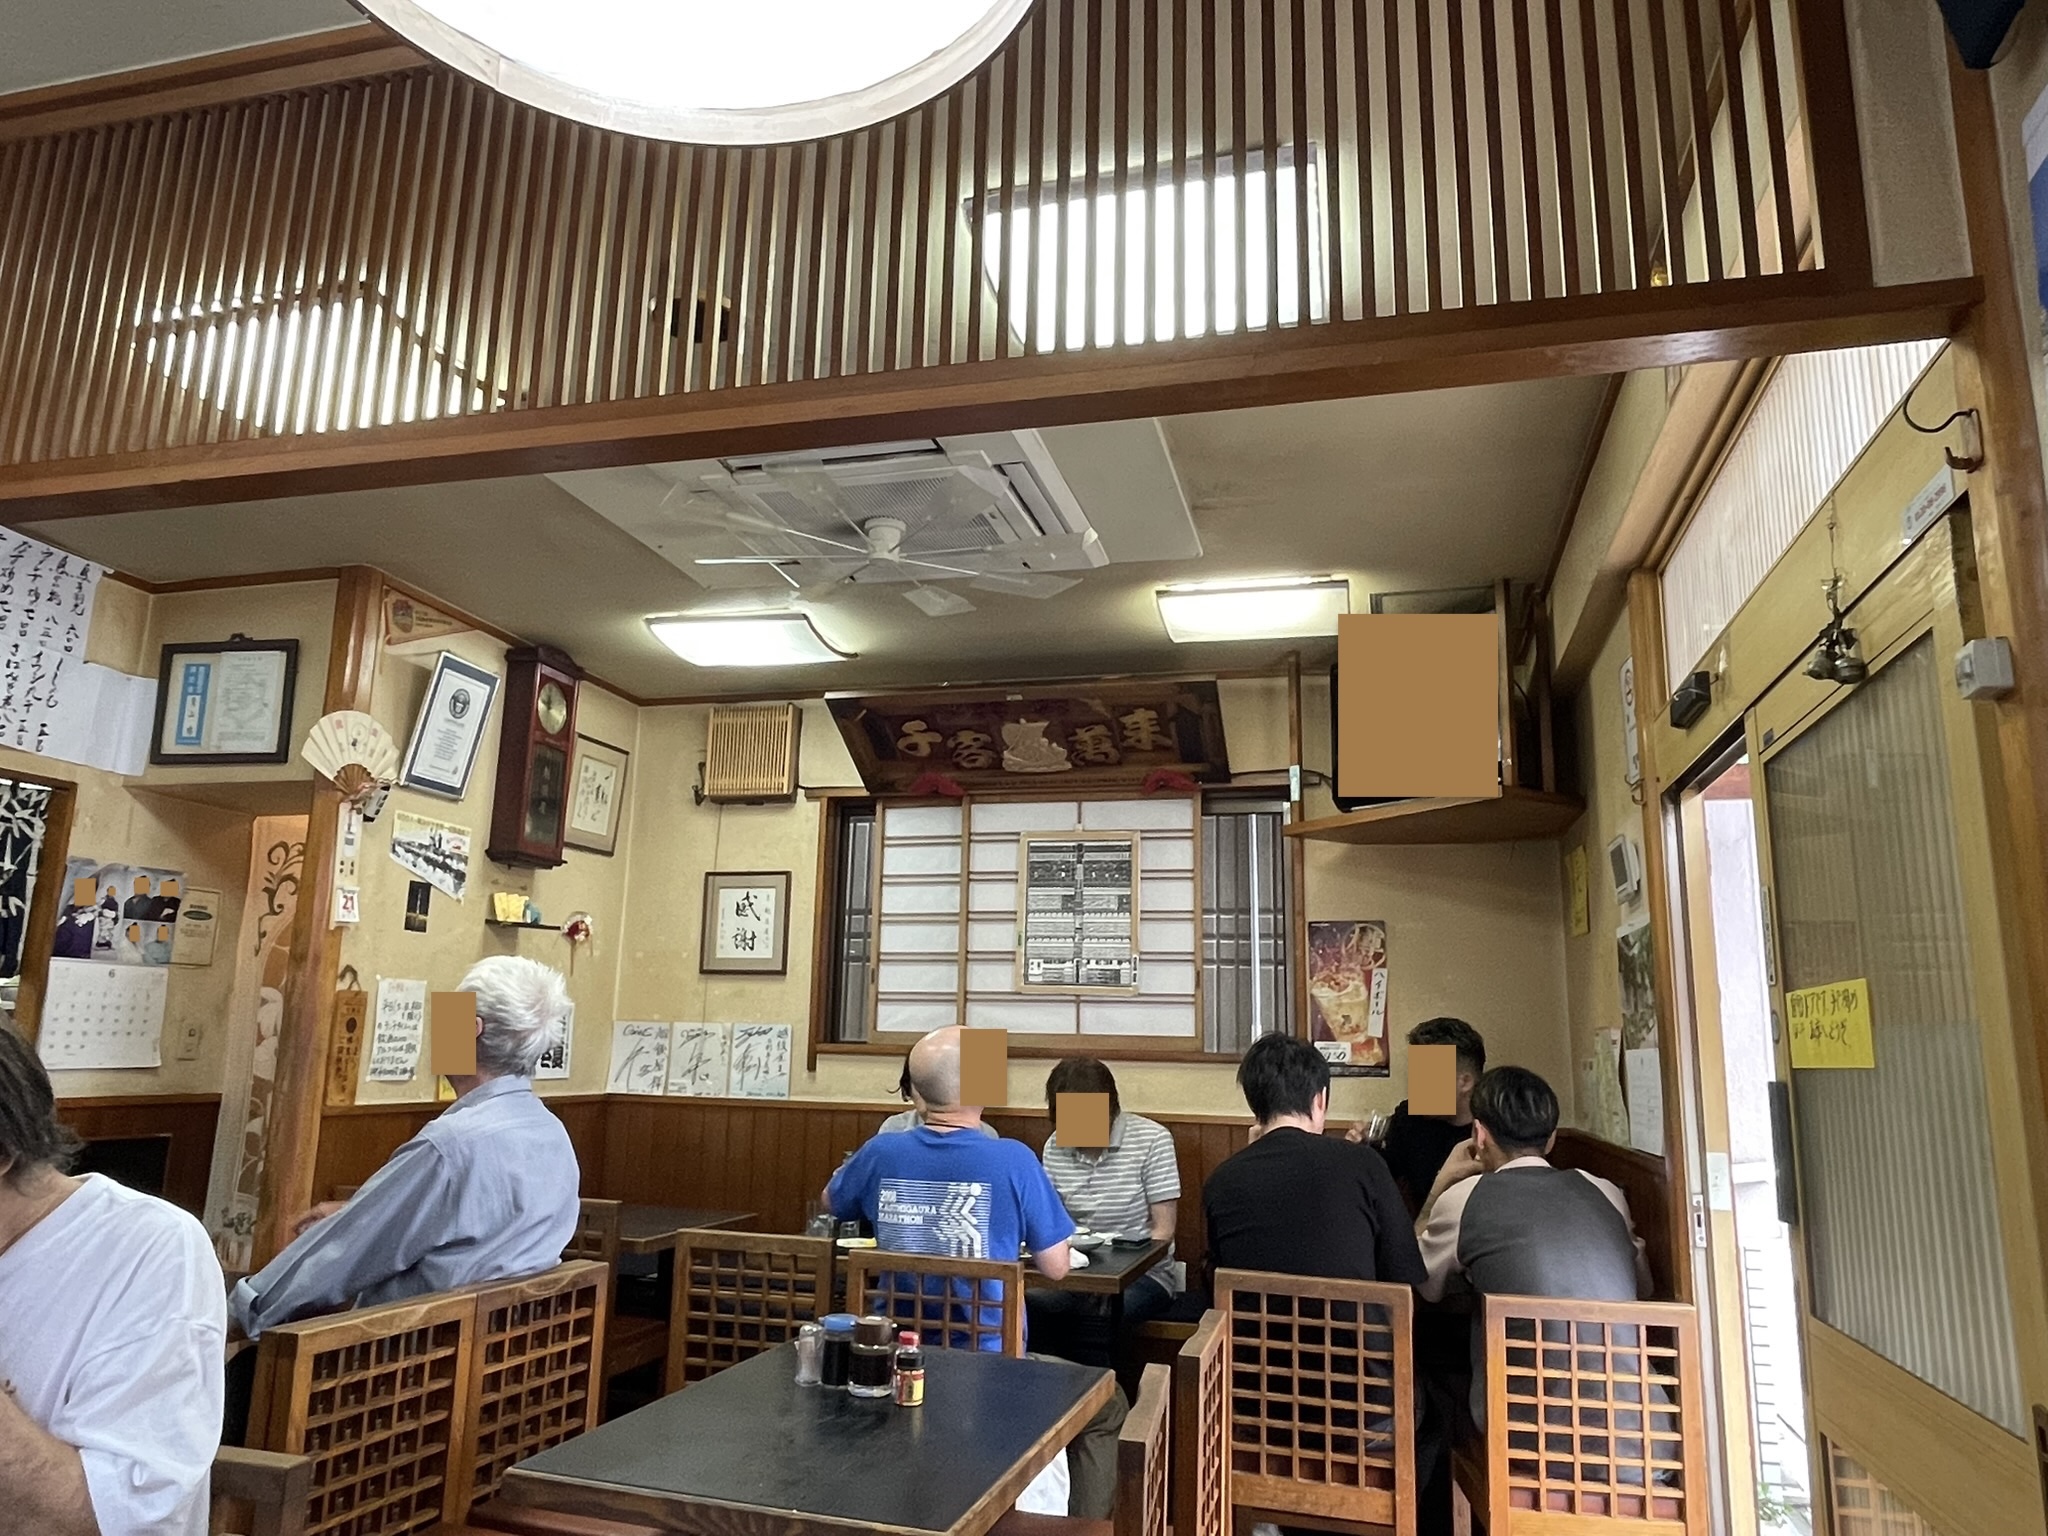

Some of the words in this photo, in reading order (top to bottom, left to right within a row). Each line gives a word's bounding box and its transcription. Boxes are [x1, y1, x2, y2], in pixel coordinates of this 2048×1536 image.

[732, 891, 762, 952] 感謝
[107, 968, 116, 979] 6
[1371, 971, 1386, 1017] ハイボール
